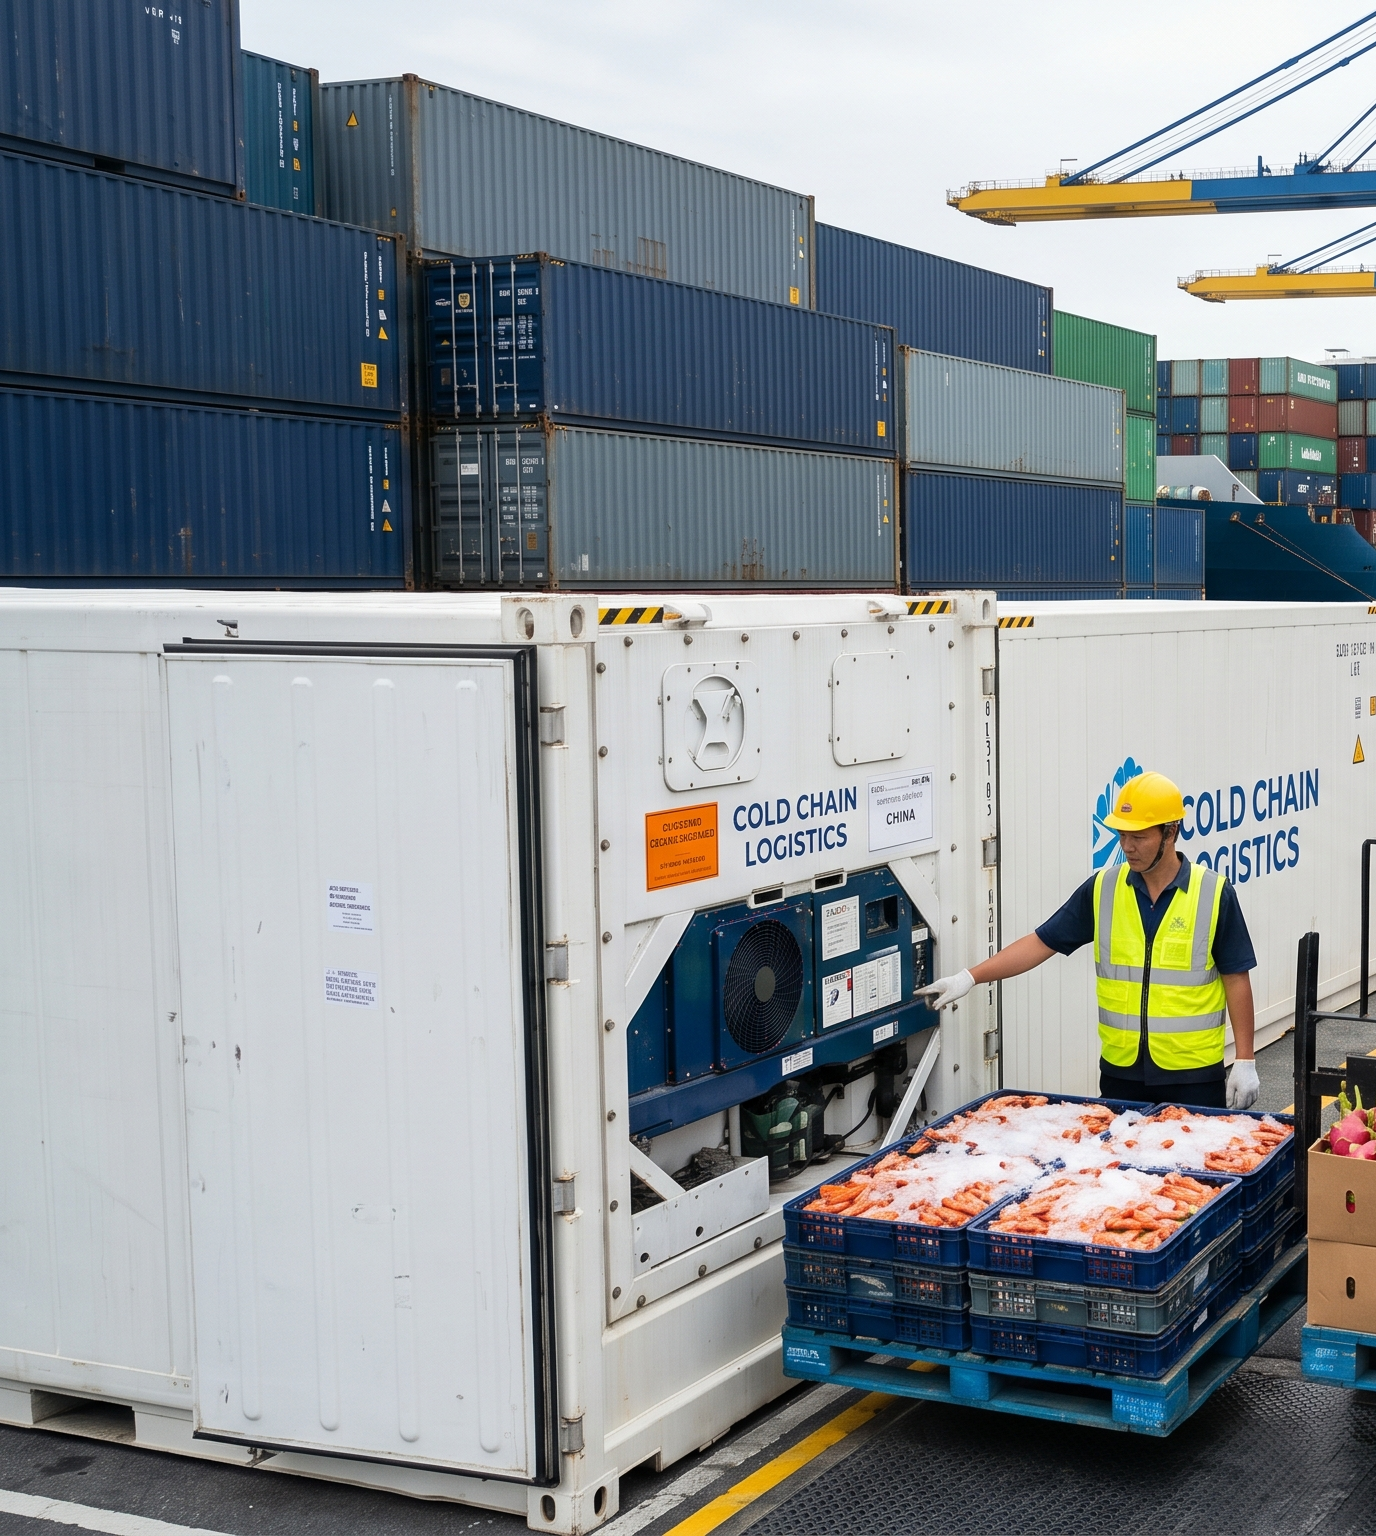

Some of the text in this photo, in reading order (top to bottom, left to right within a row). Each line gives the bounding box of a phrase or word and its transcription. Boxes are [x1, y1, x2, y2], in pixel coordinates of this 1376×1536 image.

[733, 798, 791, 832] COLD
[796, 786, 857, 820] CHAIN
[886, 808, 916, 825] CHINA
[1180, 768, 1319, 841] COLD CHAIN
[745, 822, 848, 867] LOGISTICS
